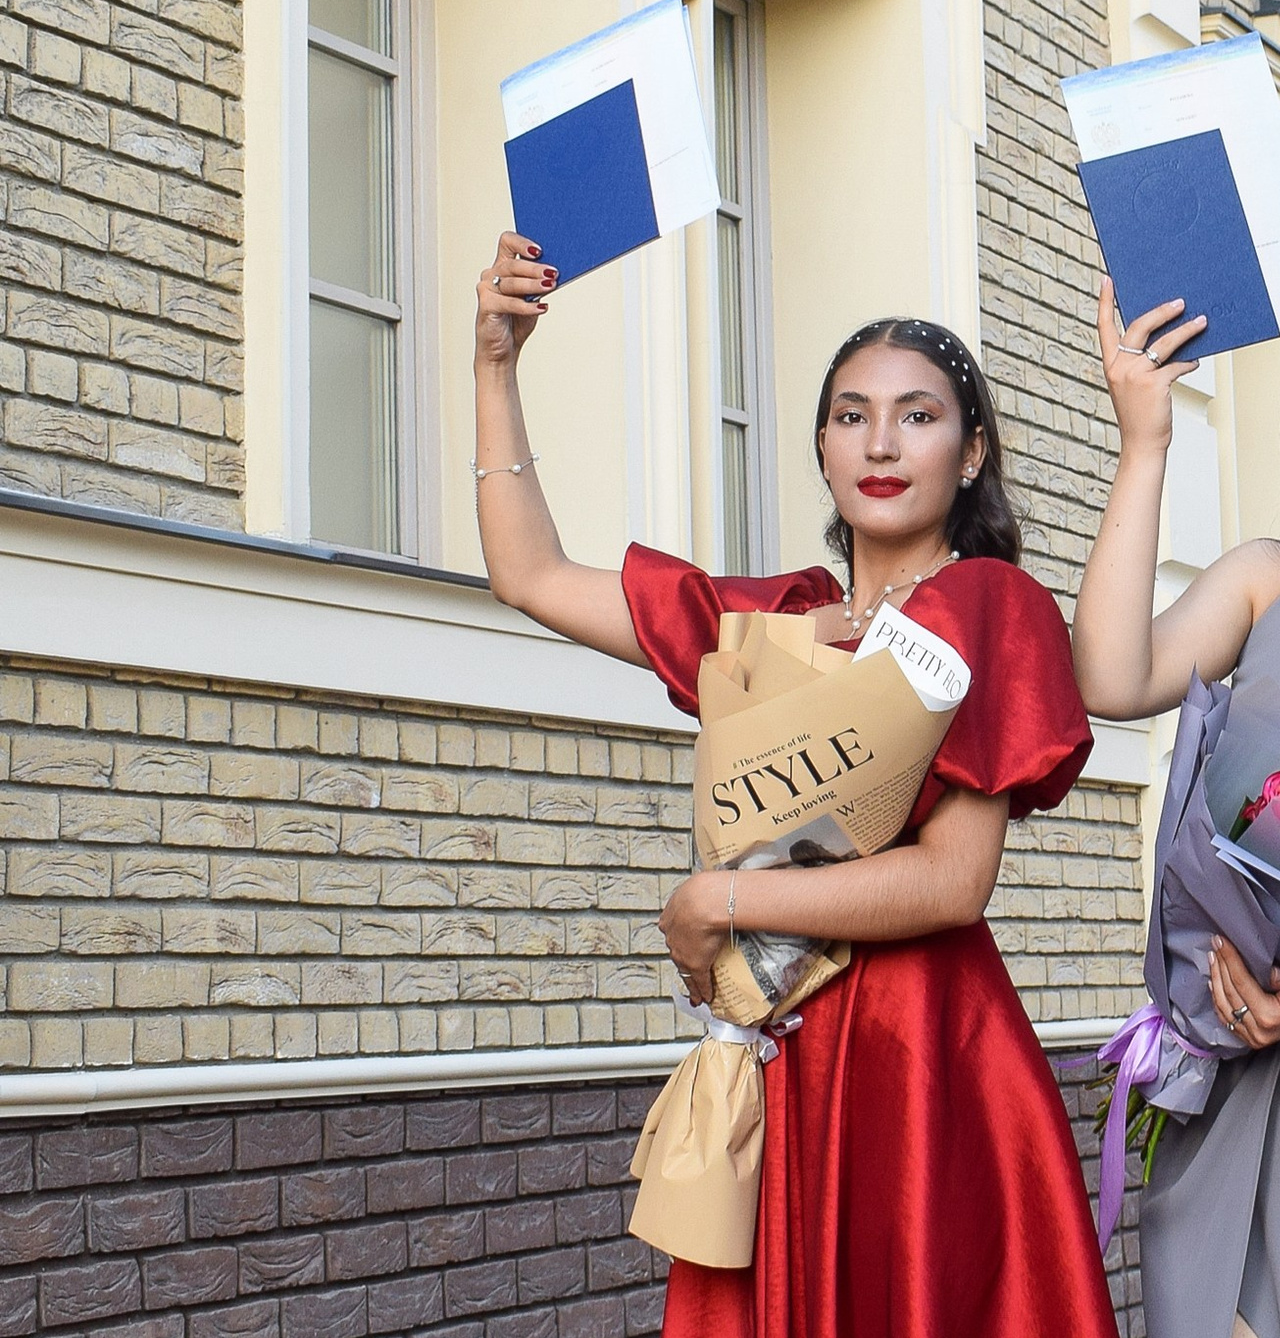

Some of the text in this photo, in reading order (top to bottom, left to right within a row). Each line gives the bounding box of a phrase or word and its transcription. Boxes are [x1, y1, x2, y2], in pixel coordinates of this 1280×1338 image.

[876, 621, 946, 677] PRETTY
[756, 744, 786, 762] essence
[787, 738, 797, 749] of
[797, 732, 812, 744] life
[711, 727, 875, 827] STYLE
[771, 789, 837, 825] Keep loving
